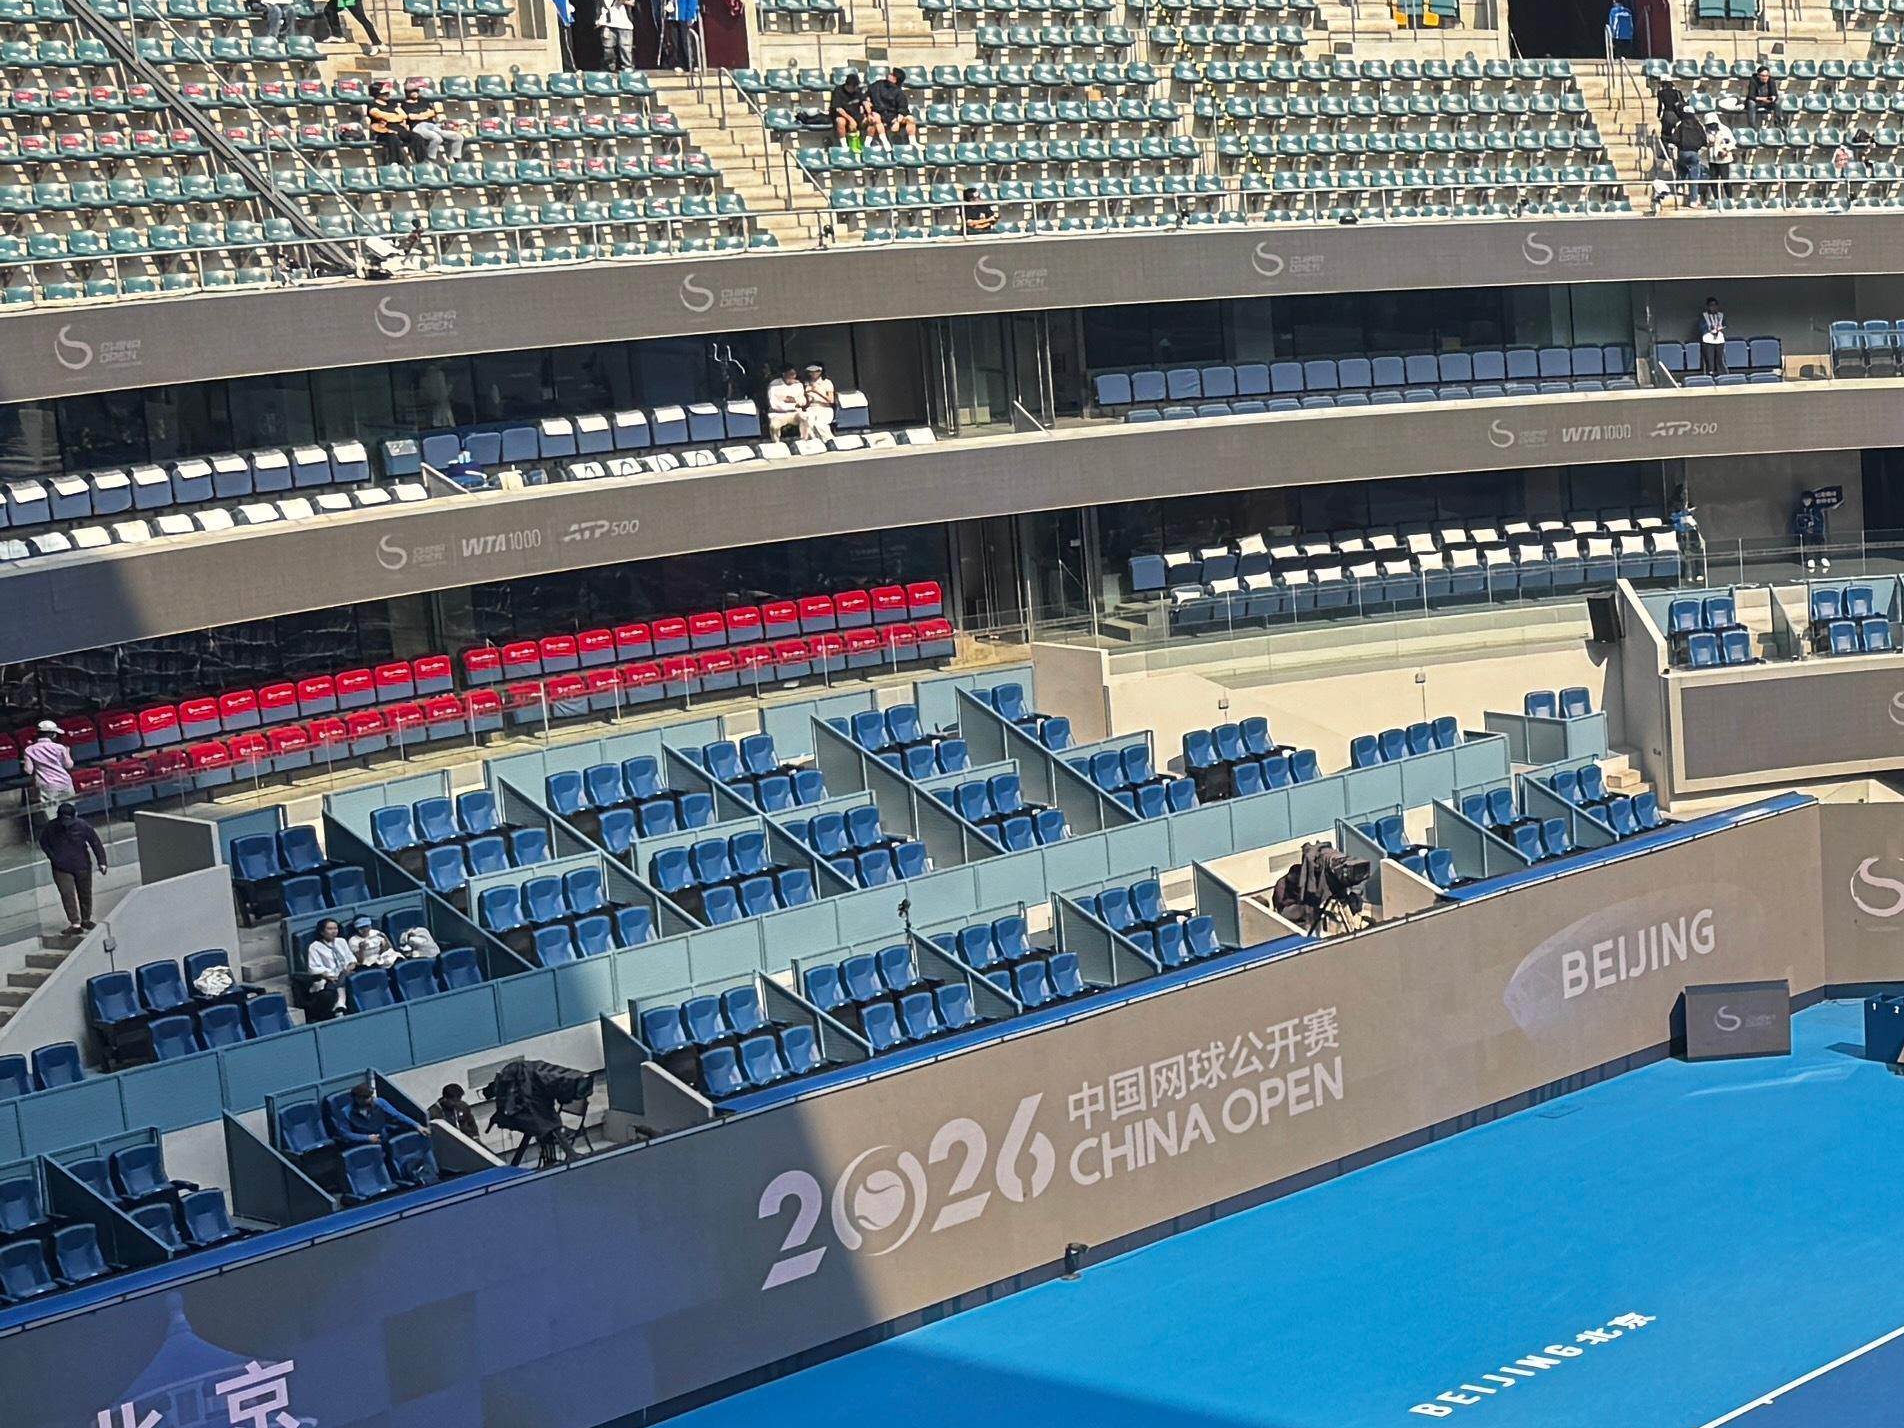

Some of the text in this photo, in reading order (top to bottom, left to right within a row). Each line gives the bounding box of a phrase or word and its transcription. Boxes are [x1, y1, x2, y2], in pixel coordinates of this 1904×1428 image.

[1562, 421, 1718, 442] WTA 1000 ATP 500
[462, 519, 640, 557] WTA 1000 ATP 500
[1560, 908, 1717, 1000] BEIJING
[1068, 1005, 1341, 1130] 中国网球公开赛
[1069, 1055, 1345, 1187] CHINA OPEN
[758, 1091, 1056, 1291] 2026
[1409, 1345, 1584, 1418] BEIJING
